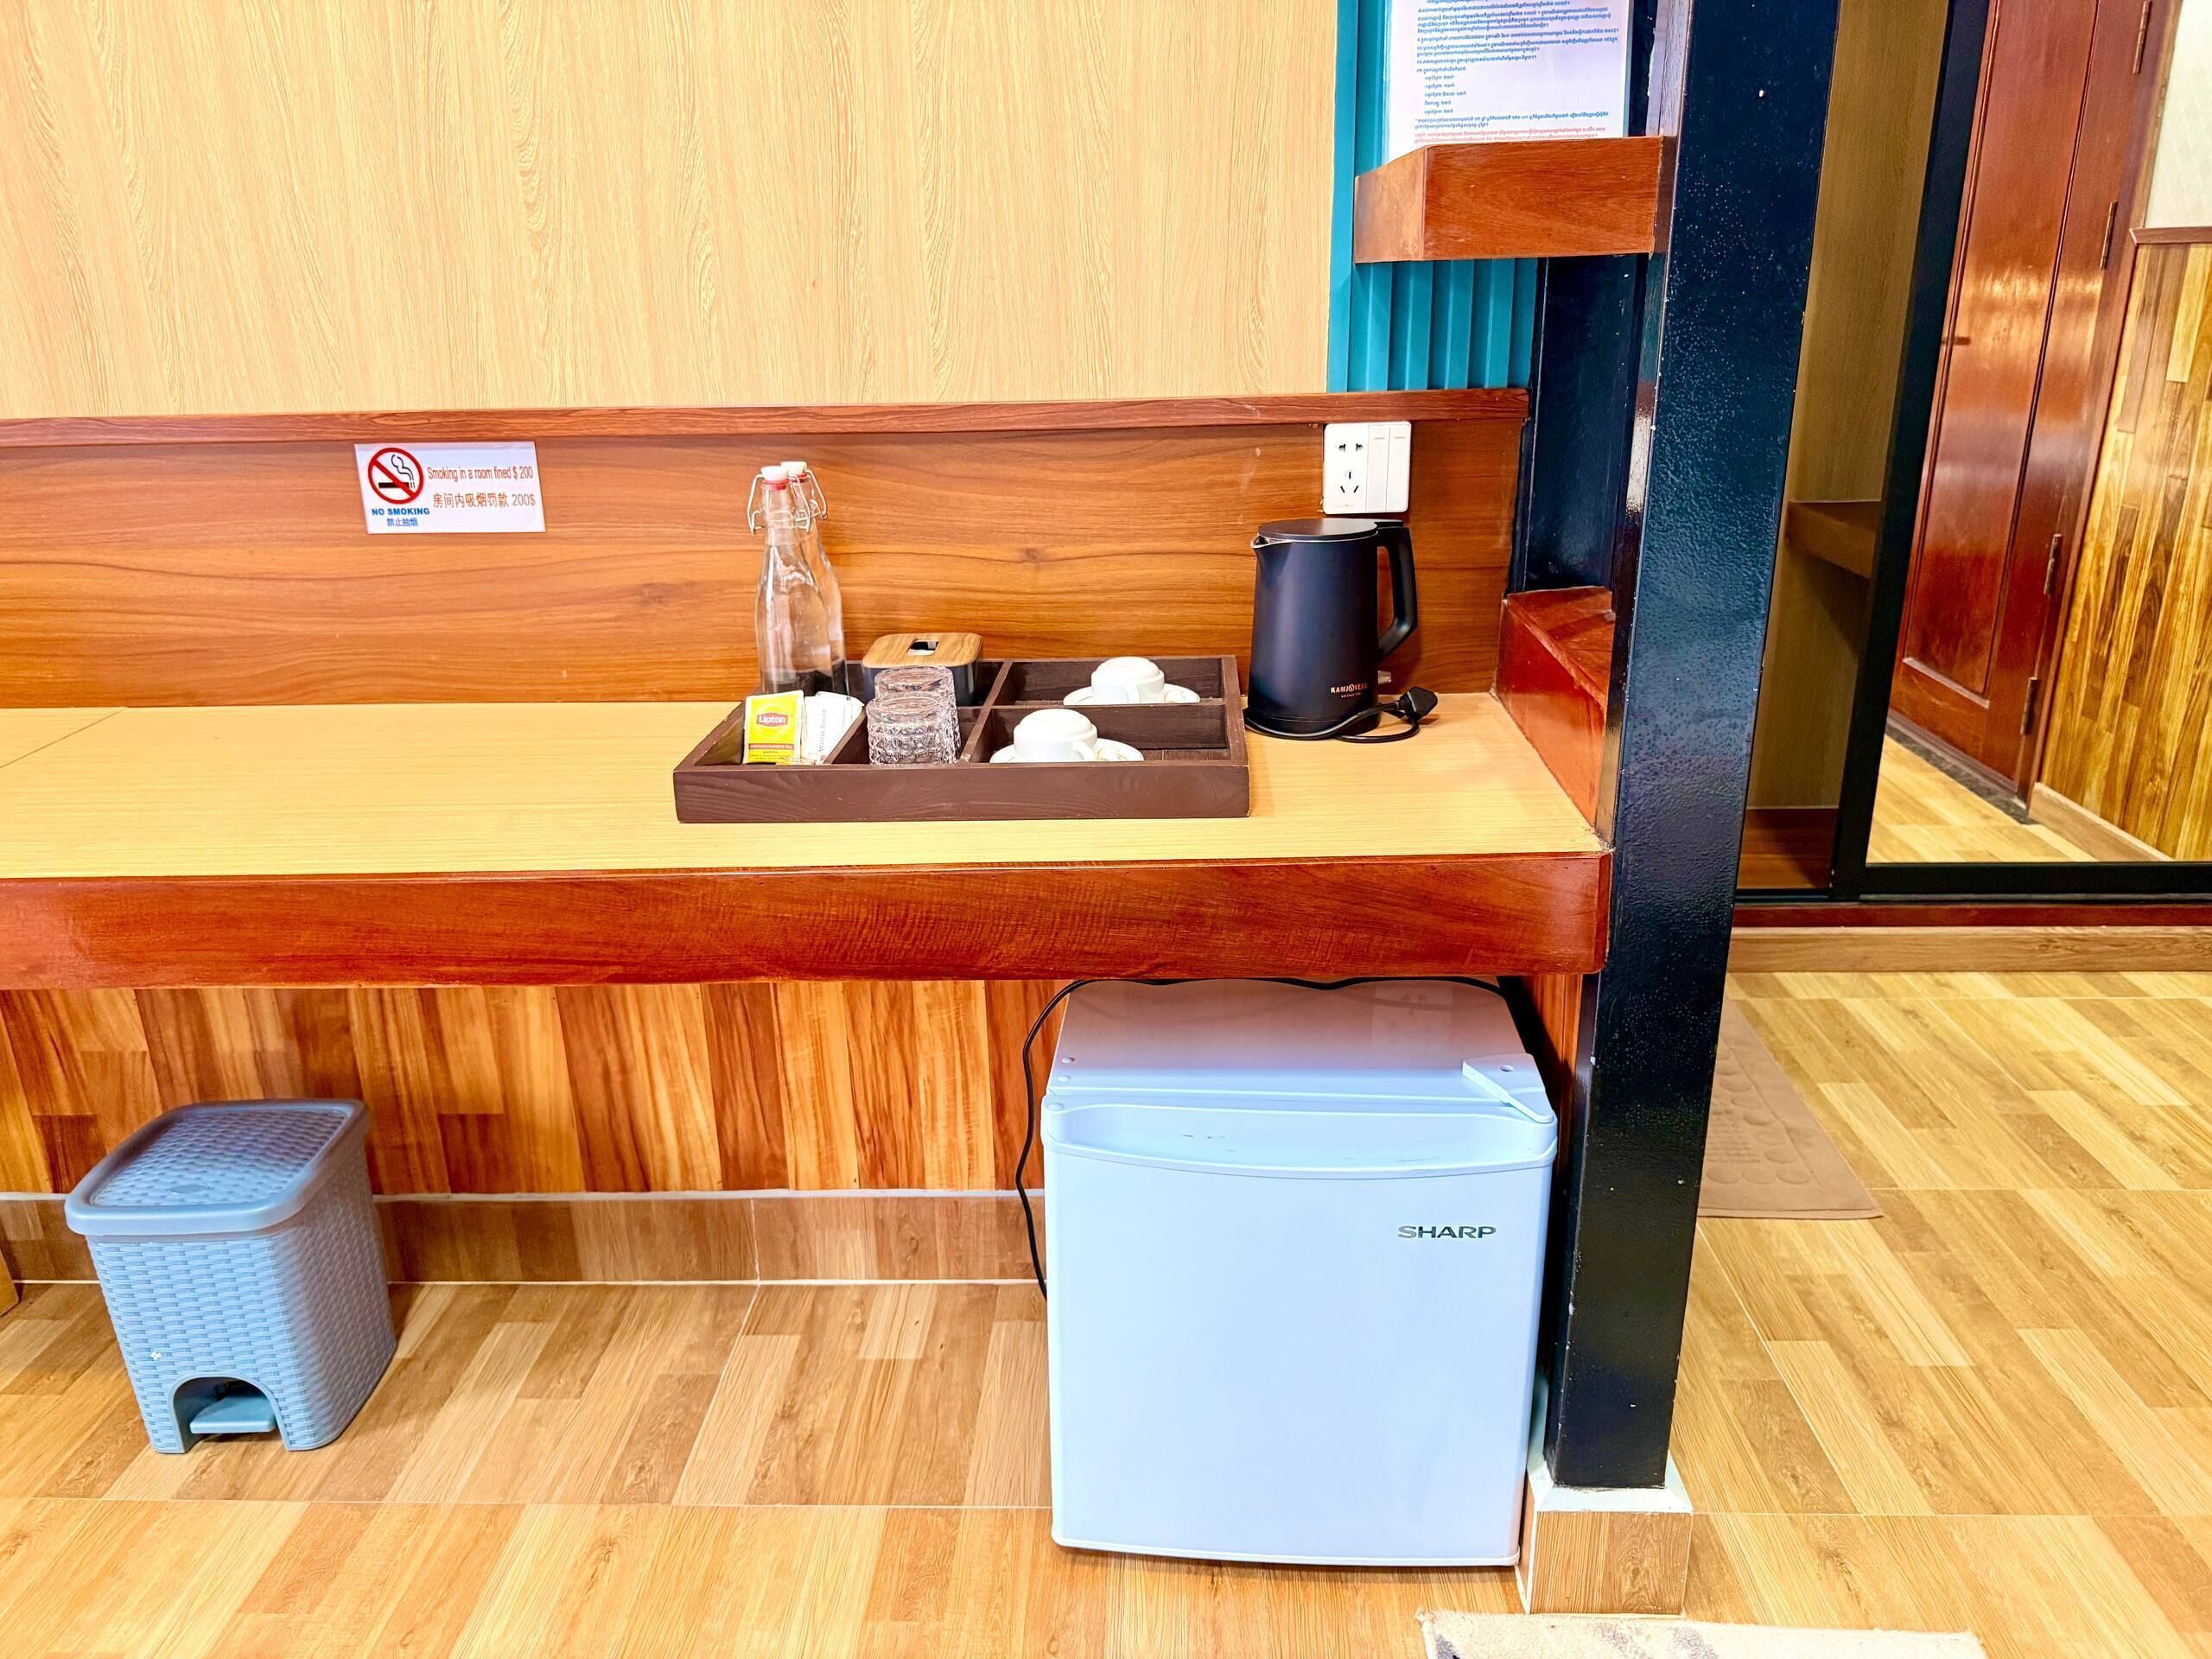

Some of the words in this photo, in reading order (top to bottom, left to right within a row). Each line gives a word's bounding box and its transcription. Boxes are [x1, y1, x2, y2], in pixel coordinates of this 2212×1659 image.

[427, 466, 459, 482] Smoking
[459, 467, 467, 480] in
[467, 469, 474, 480] a
[474, 469, 491, 480] room
[493, 466, 512, 480] fined
[512, 466, 518, 480] $
[520, 466, 533, 479] 200
[434, 493, 509, 508] 房间内吸烟罚款
[512, 493, 536, 506] 200$
[372, 507, 385, 516] NO
[759, 715, 785, 725] Lipton
[1397, 1225, 1497, 1238] SHARP
